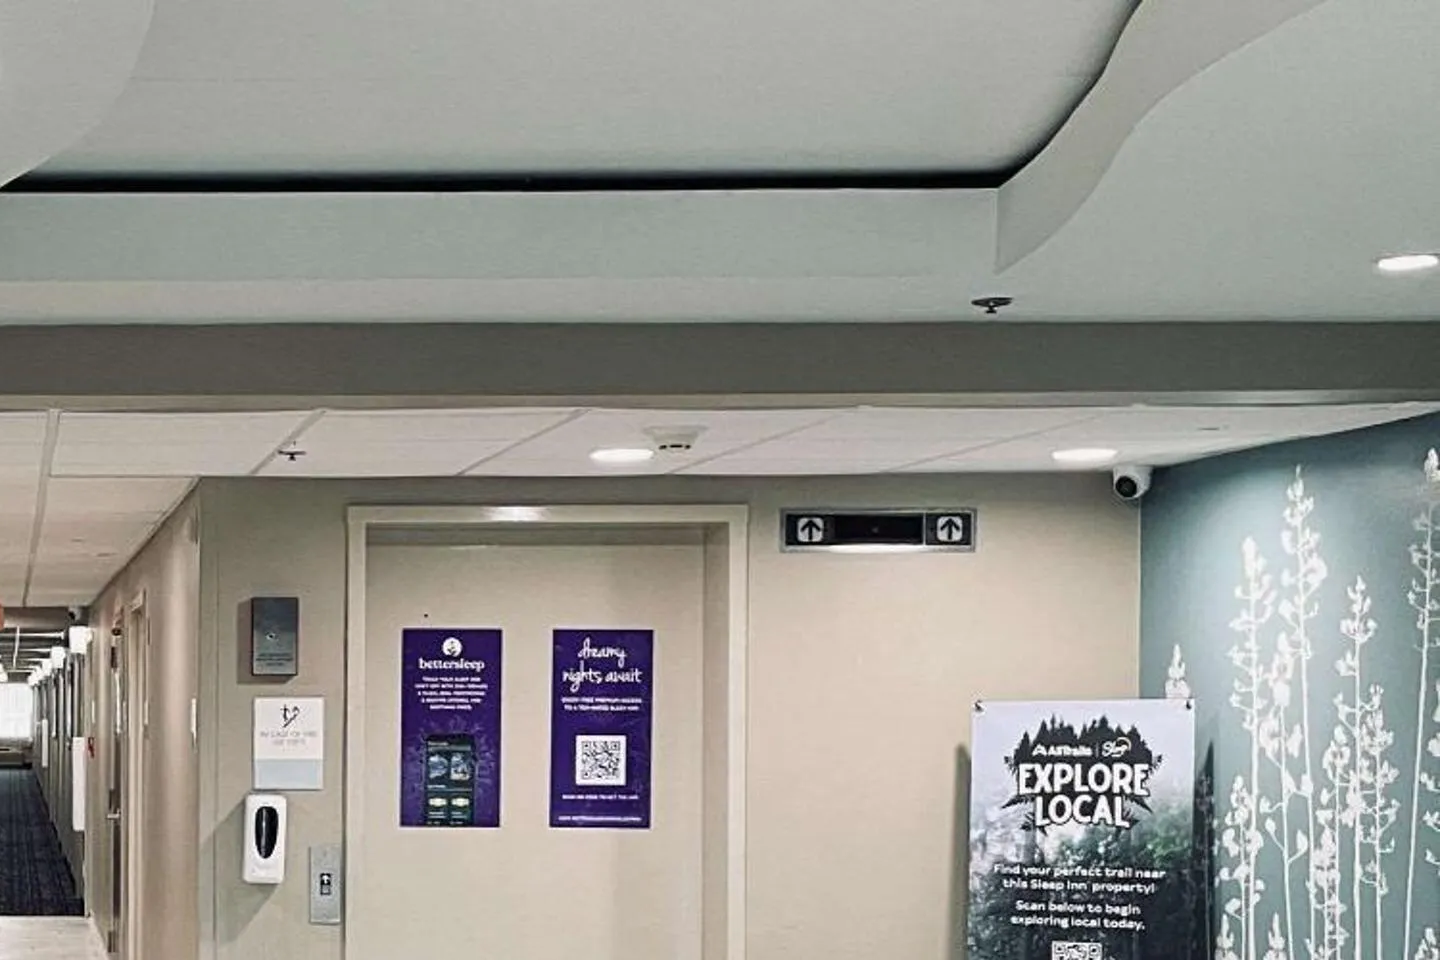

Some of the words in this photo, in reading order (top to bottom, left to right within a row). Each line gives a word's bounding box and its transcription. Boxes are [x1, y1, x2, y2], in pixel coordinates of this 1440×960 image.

[577, 637, 627, 668] dreamy
[418, 657, 485, 672] bettersleep
[562, 660, 602, 693] nights
[605, 667, 642, 683] await
[1018, 762, 1151, 797] EXPLORE
[1034, 794, 1131, 829] LOCAL
[993, 863, 1021, 875] Find
[1022, 866, 1051, 877] your
[1053, 865, 1103, 878] perfect
[1104, 867, 1133, 878] trail
[1135, 869, 1166, 879] near
[1002, 877, 1028, 889] this
[1029, 878, 1065, 892] Sleep
[1091, 881, 1155, 895] property!
[1015, 900, 1046, 911] Scan
[1048, 901, 1086, 913] below
[1086, 902, 1103, 913] to
[1105, 903, 1141, 917] begin
[1010, 914, 1069, 929] exploring
[1070, 916, 1101, 928] local
[1103, 918, 1146, 932] today.
